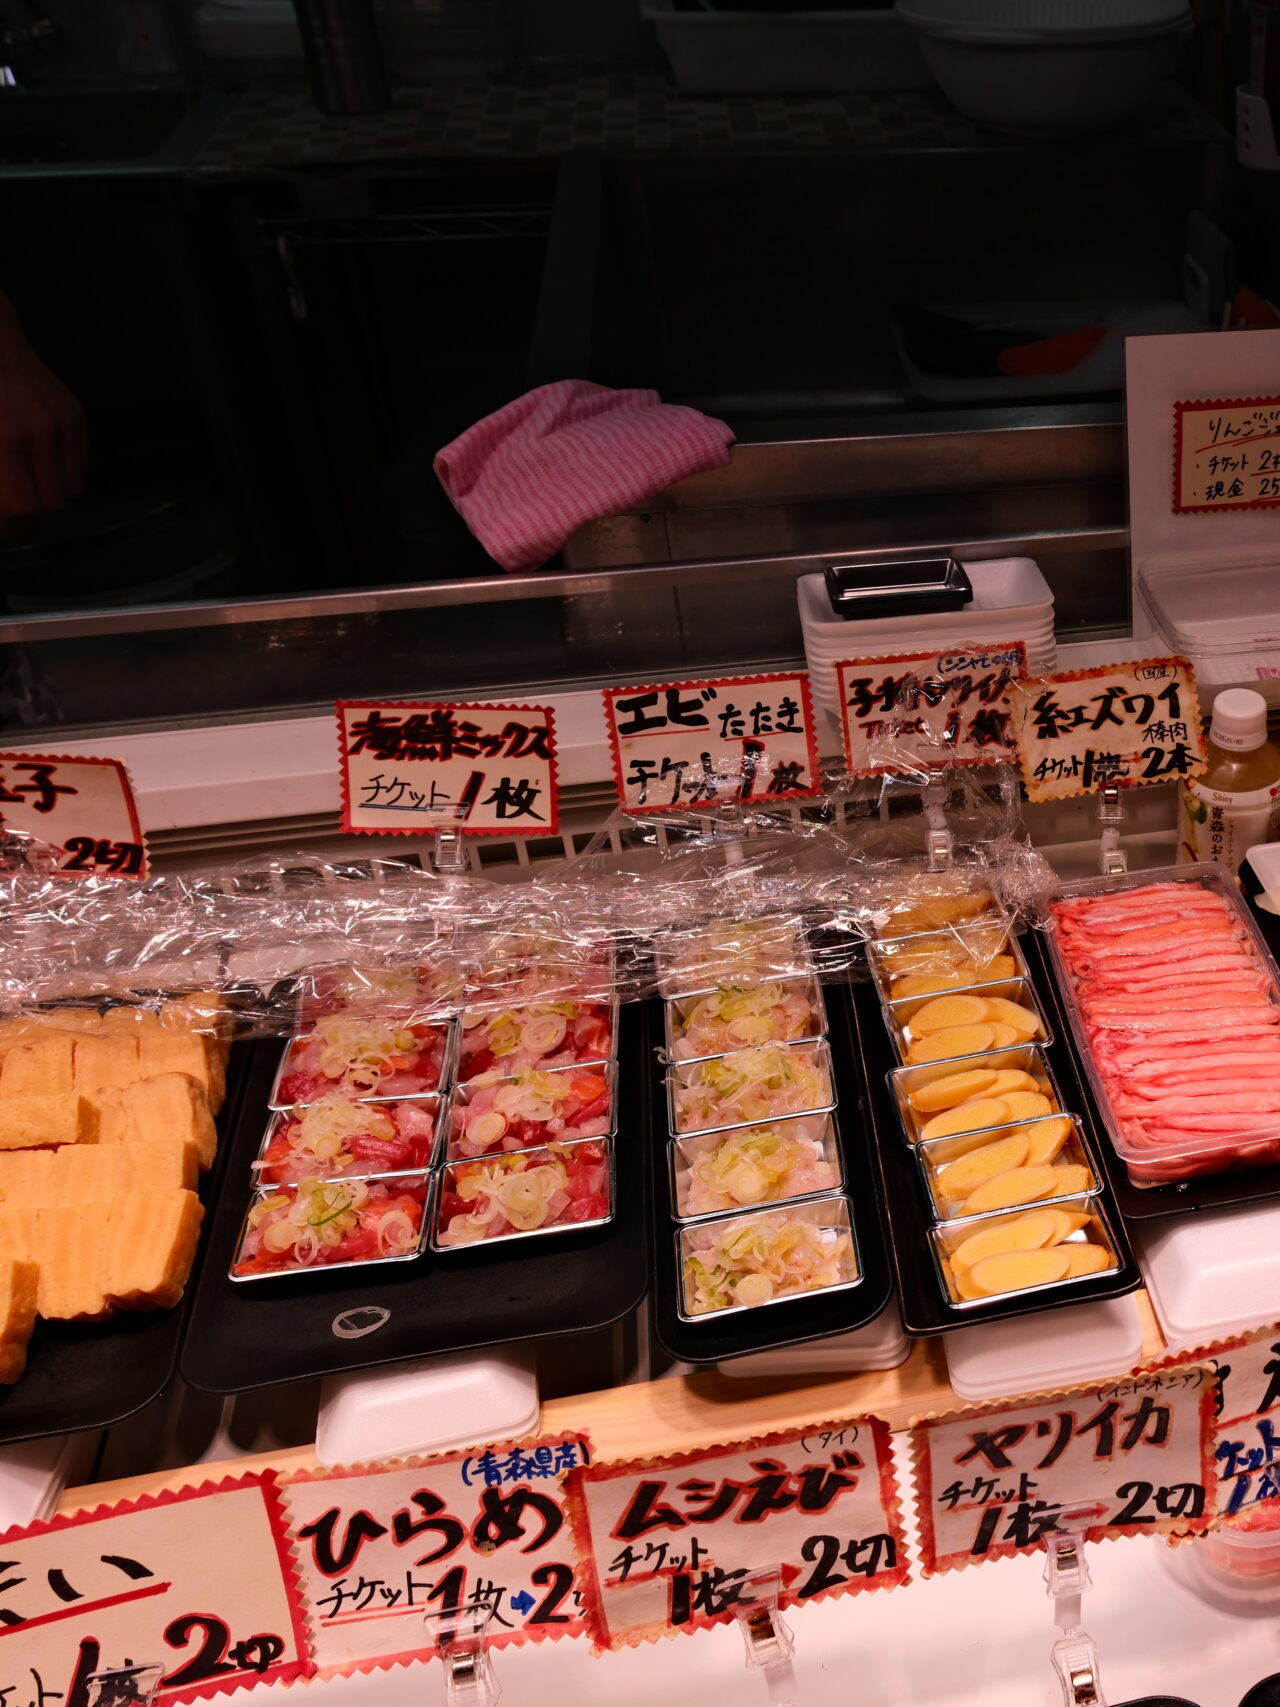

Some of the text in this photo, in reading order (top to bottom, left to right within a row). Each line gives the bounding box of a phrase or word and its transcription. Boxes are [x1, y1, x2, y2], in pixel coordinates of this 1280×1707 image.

[349, 710, 555, 762] 海鮮ミックス
[1032, 682, 1182, 740] 紅ズワイ
[1211, 791, 1233, 805] Shiny
[1209, 806, 1225, 862] 青森のお
[801, 1426, 859, 1454] (タイ)
[954, 1396, 1174, 1470] ヤリイカ
[461, 1440, 590, 1487] (青森県産)
[612, 1451, 862, 1540] ムシえび
[938, 1472, 1039, 1509] チケット
[298, 1484, 565, 1577] ひらめ
[608, 1536, 709, 1583] チケット
